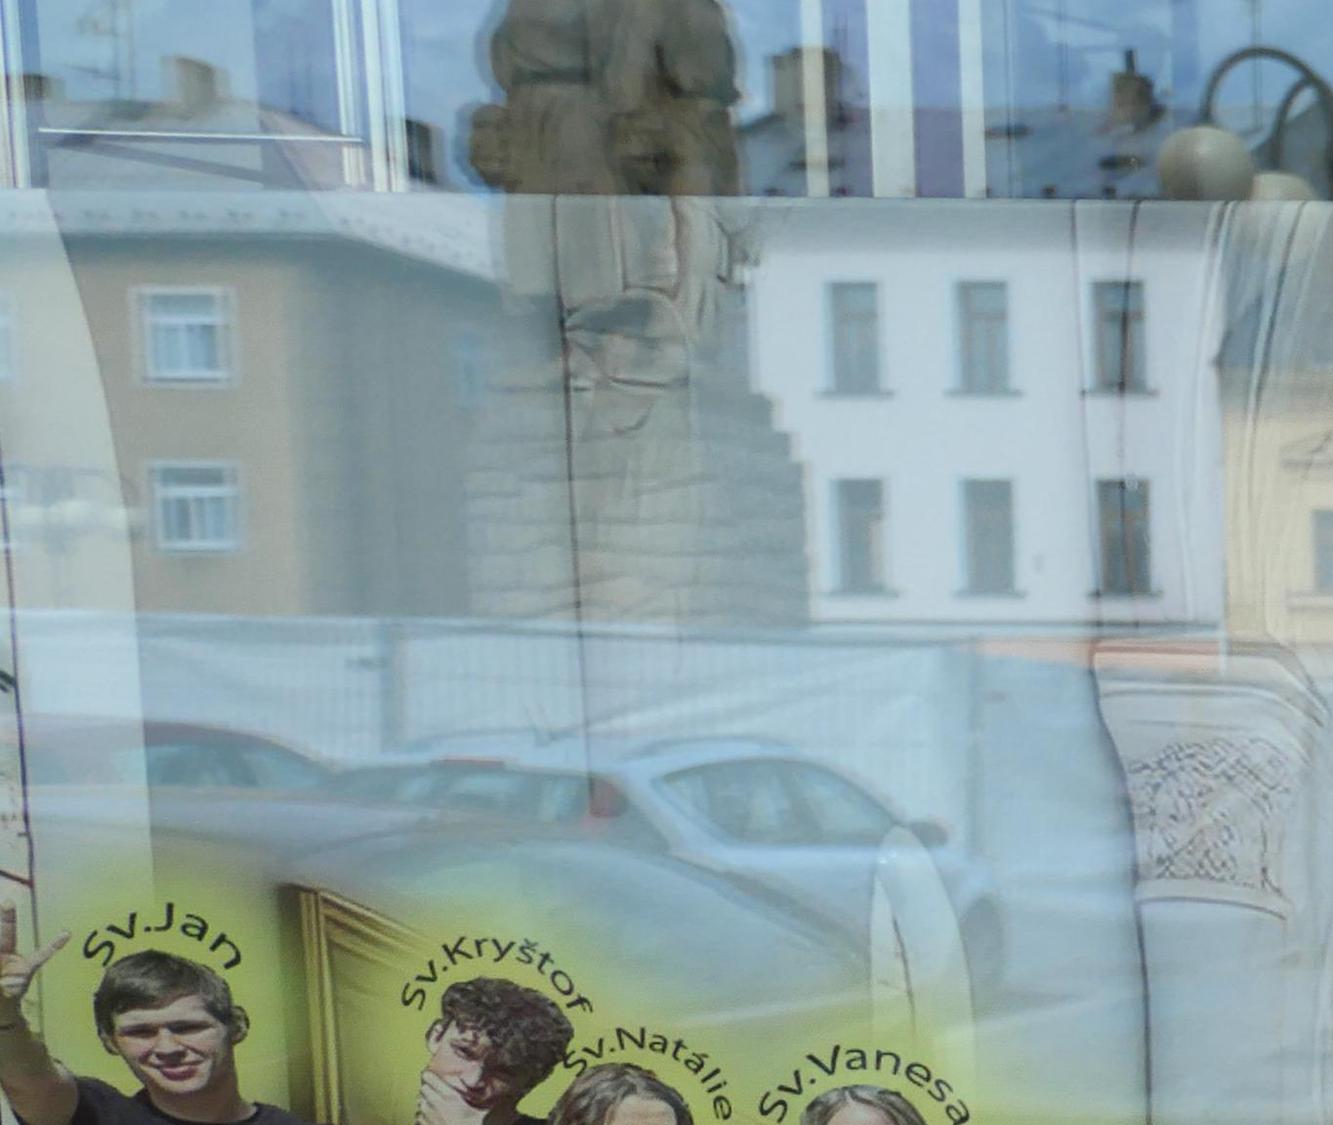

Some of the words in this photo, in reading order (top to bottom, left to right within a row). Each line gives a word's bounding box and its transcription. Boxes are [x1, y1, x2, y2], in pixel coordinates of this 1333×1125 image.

[82, 902, 243, 969] Sv.Jan
[401, 935, 594, 1017] Sv.Kryštof
[561, 1026, 733, 1121] Sv.Natálie
